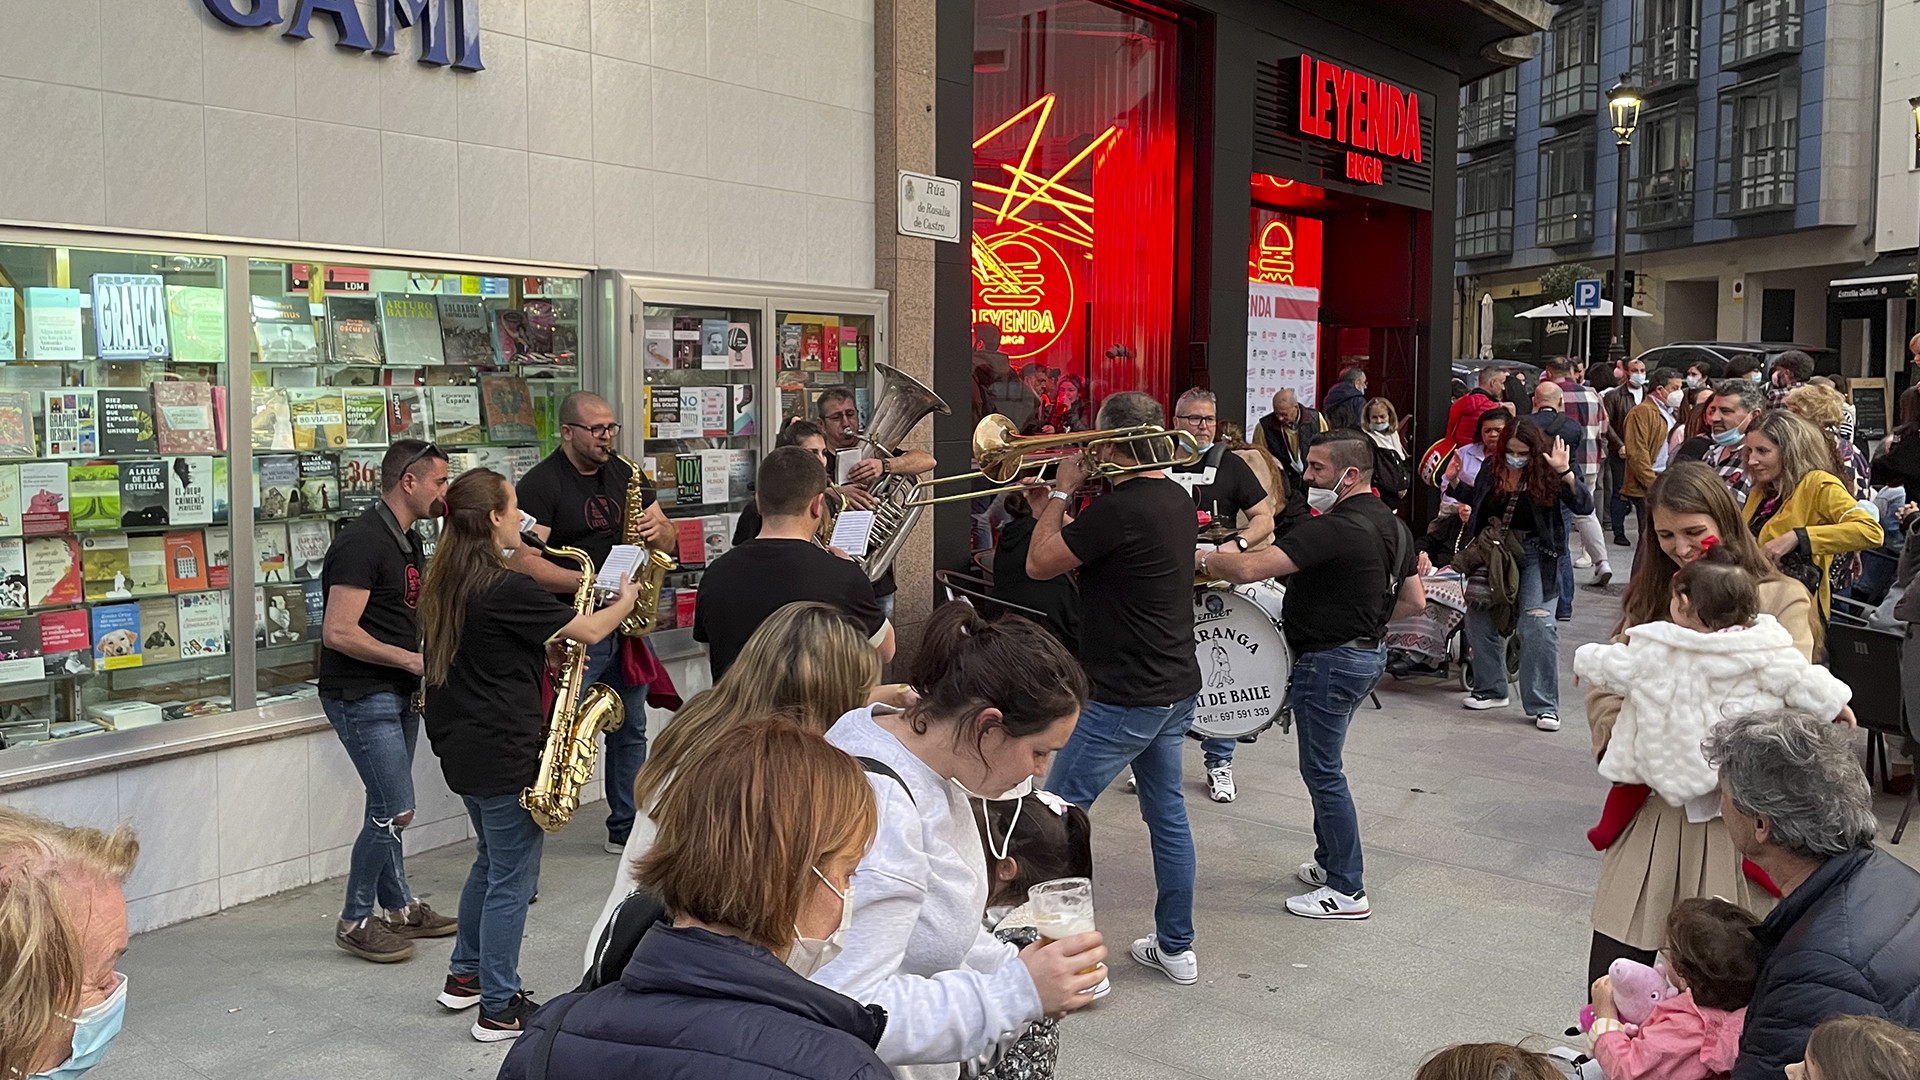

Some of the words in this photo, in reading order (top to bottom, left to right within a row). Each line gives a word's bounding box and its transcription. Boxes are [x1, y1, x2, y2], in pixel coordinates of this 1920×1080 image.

[1300, 53, 1422, 164] LEYENDA
[1346, 151, 1384, 186] BRGR
[926, 181, 946, 197] Rúa
[917, 201, 926, 213] de
[913, 216, 922, 228] de
[923, 218, 946, 232] Castro
[98, 276, 162, 286] RUTA
[344, 282, 365, 291] LDM
[1580, 283, 1597, 306] P
[386, 299, 434, 310] ARTURO
[1000, 335, 1025, 345] BRGR
[446, 397, 470, 406] España
[679, 396, 698, 407] NO
[346, 405, 374, 413] Paseos
[50, 414, 78, 428] GRAPHIC
[299, 416, 310, 424] 80
[311, 414, 341, 423] VIAJES
[347, 418, 377, 426] viñedos
[348, 459, 376, 483] 36
[676, 459, 701, 484] VOX
[124, 482, 165, 491] ESTRELLAS
[1208, 691, 1227, 706] DE
[1230, 685, 1271, 704] BAILE
[1220, 710, 1235, 722] 697
[1237, 708, 1253, 719] 591
[1253, 706, 1270, 718] 339
[1319, 897, 1340, 913] N
